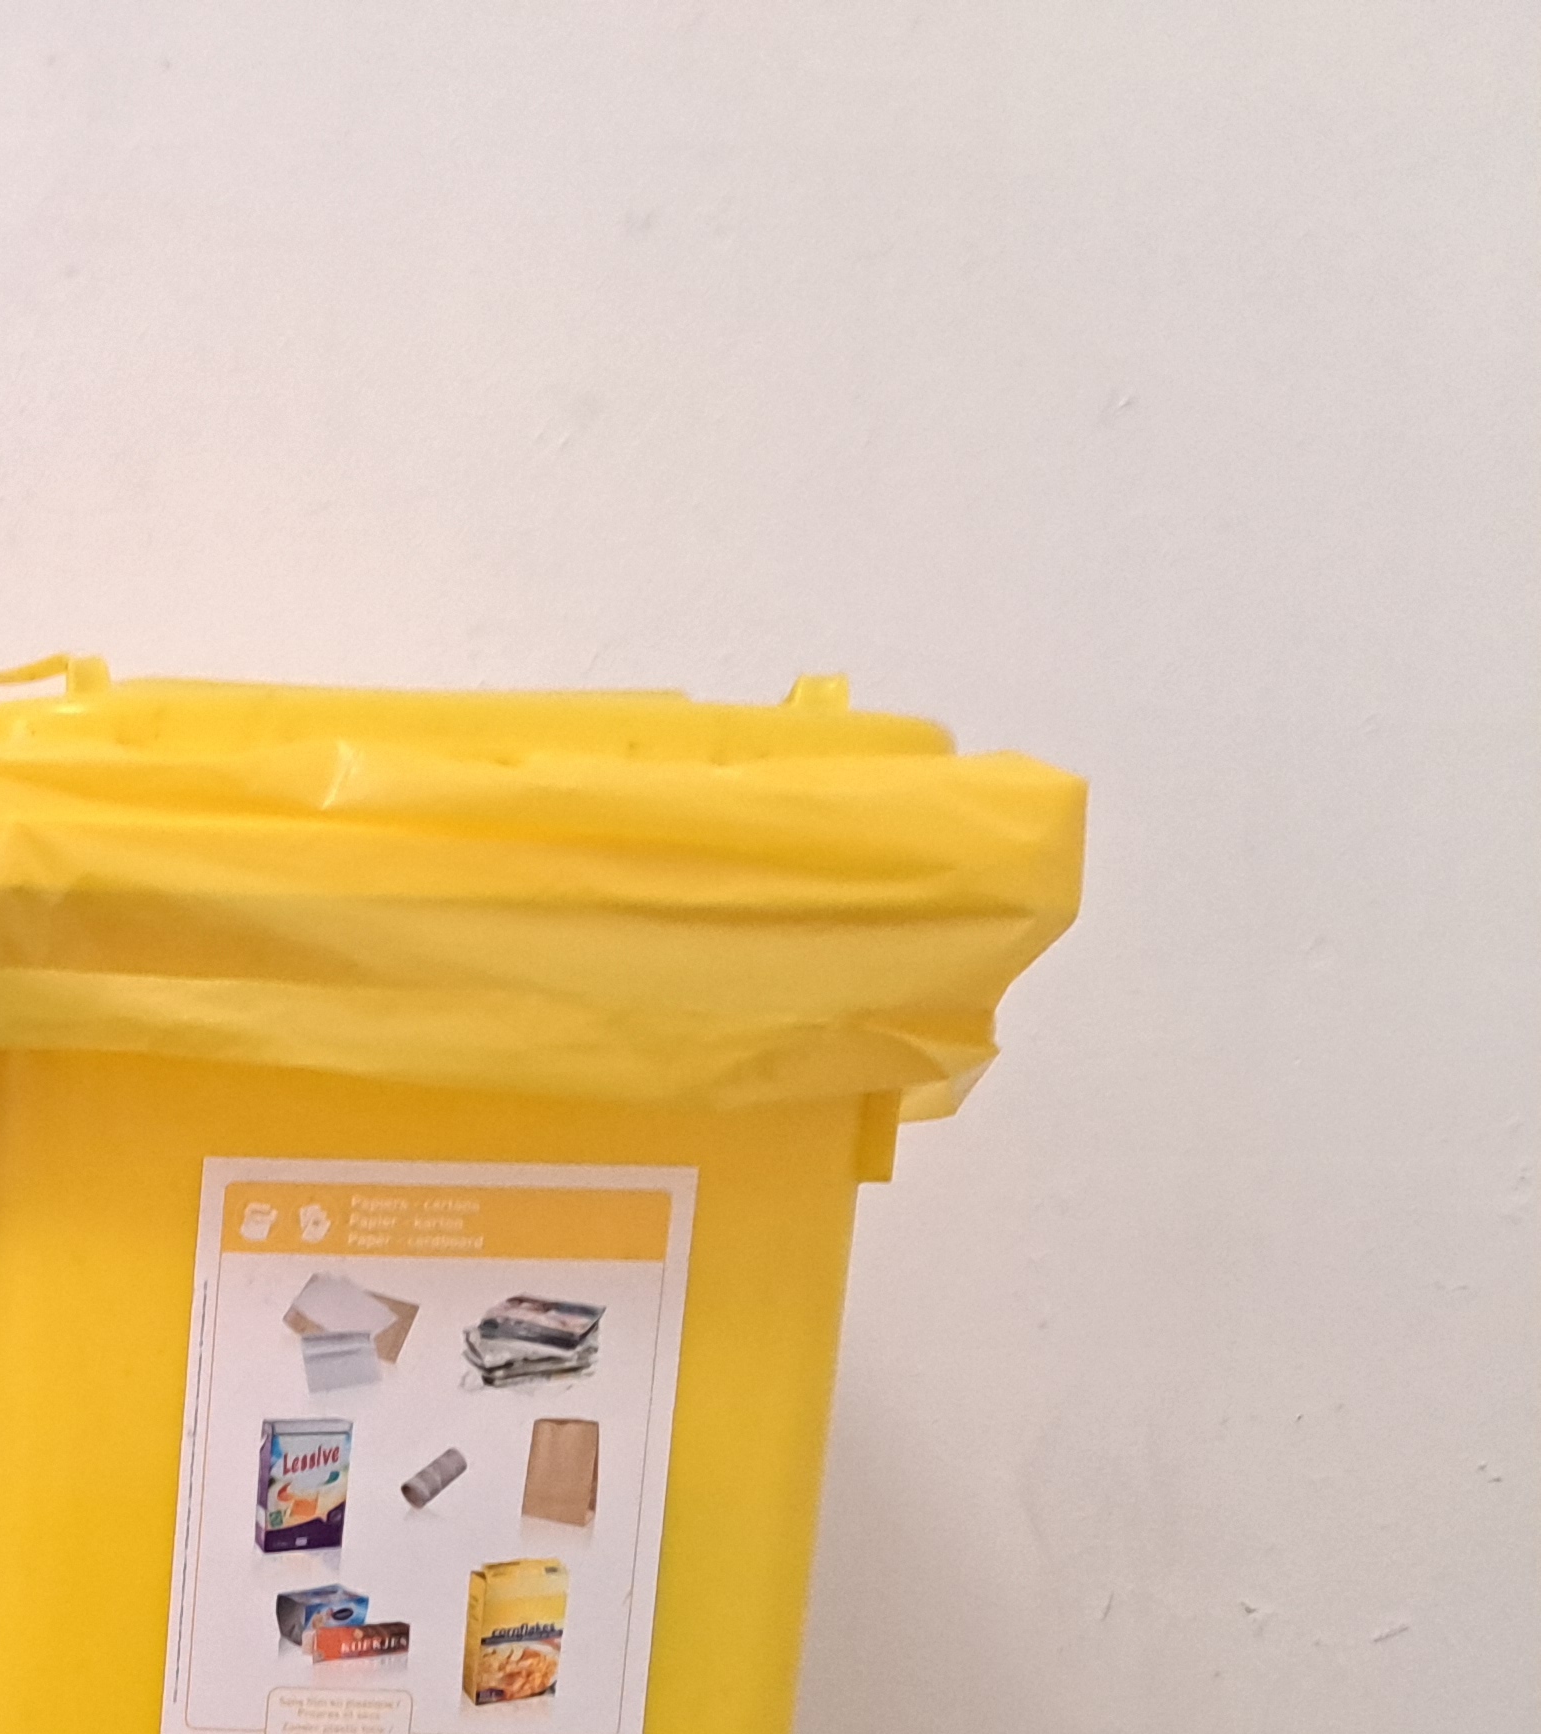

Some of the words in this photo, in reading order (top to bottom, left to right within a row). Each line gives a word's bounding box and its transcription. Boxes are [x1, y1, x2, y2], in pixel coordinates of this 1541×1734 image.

[348, 1213, 396, 1230] Papier
[347, 1233, 390, 1248] Paper
[282, 1443, 340, 1476] Lessive
[491, 1621, 556, 1641] cornflakes
